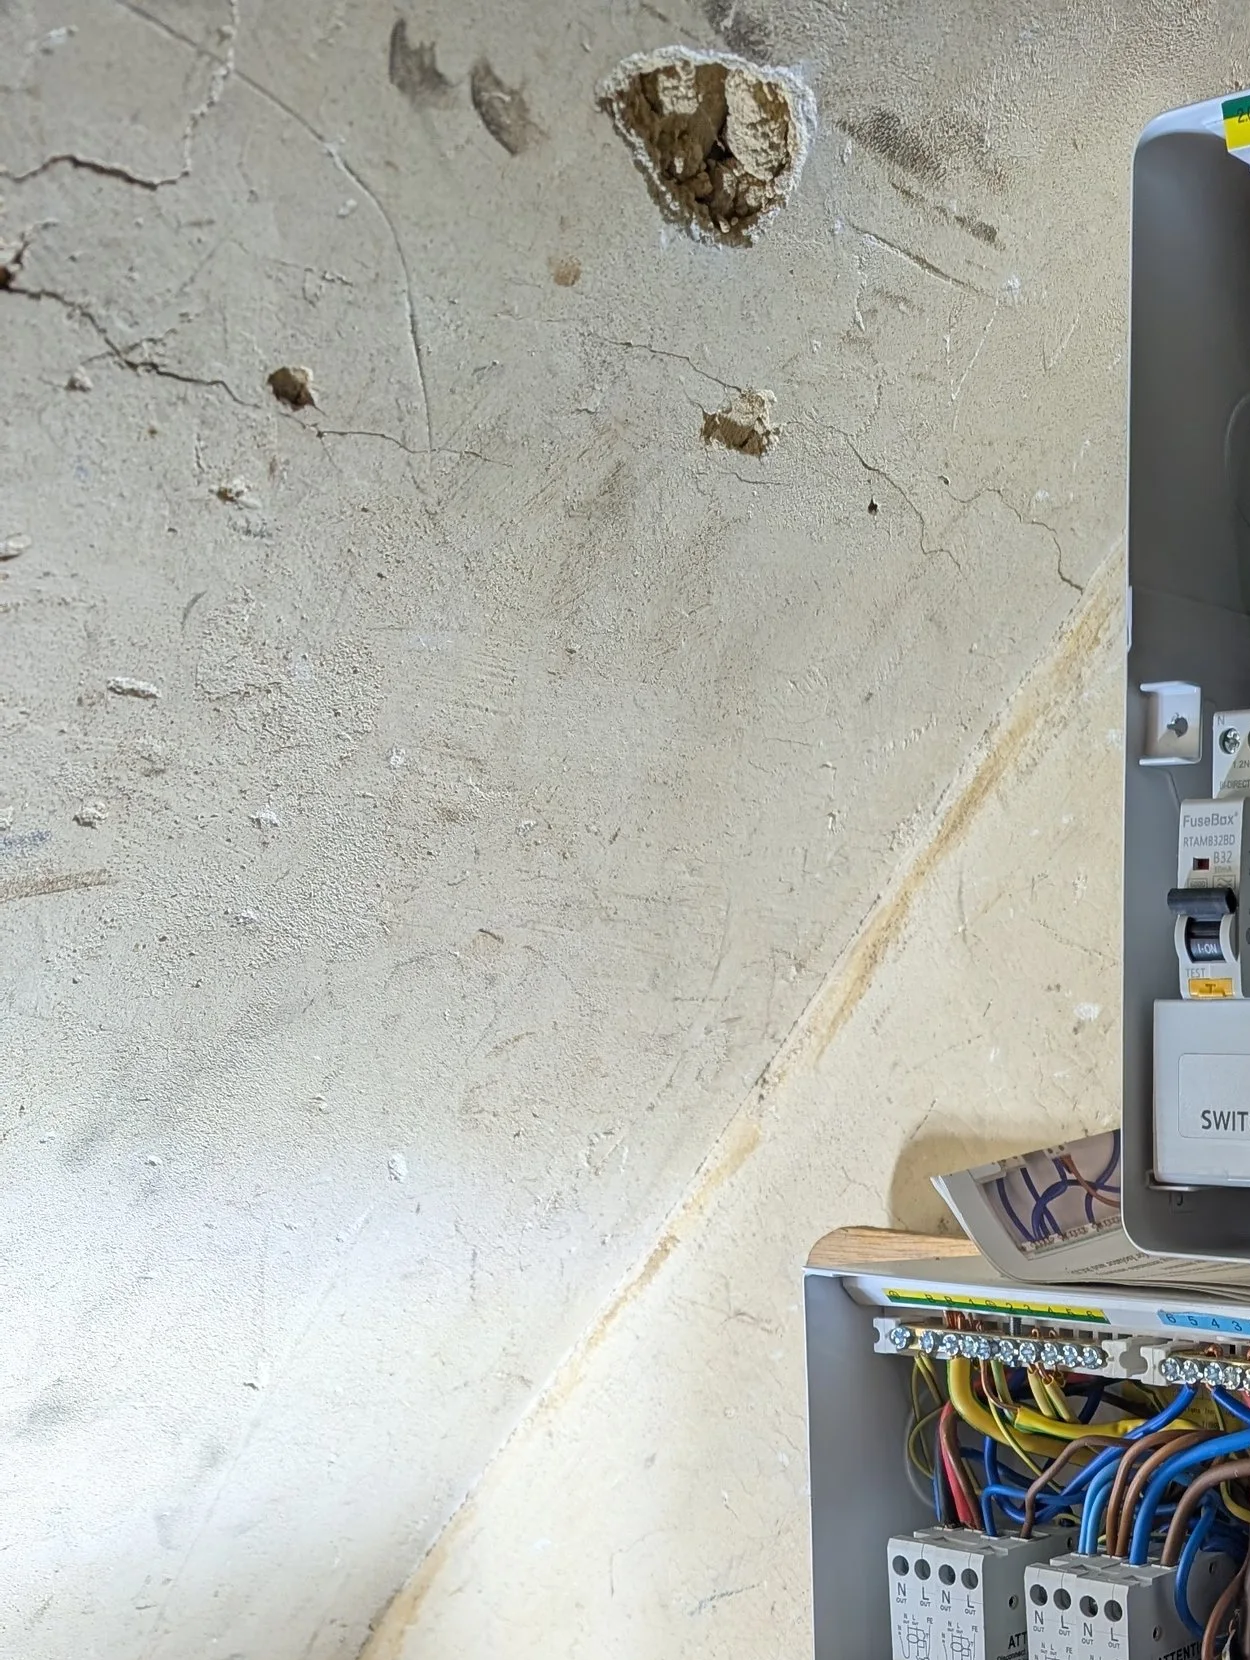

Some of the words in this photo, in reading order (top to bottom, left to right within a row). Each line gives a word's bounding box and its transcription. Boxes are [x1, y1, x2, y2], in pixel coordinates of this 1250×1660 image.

[1217, 715, 1224, 725] N
[1183, 834, 1235, 847] RTAMB32BD
[1213, 851, 1232, 864] B32
[1185, 968, 1205, 977] TEST
[1166, 1314, 1177, 1324] 6
[1188, 1316, 1198, 1326] 5
[1211, 1318, 1220, 1328] 4
[1232, 1320, 1242, 1331] 3
[897, 1582, 906, 1597] N
[922, 1586, 930, 1601] L
[942, 1590, 951, 1605] N
[967, 1594, 975, 1609] L
[965, 1608, 976, 1616] OUT
[1034, 1610, 1044, 1625] N
[1061, 1615, 1069, 1630] L
[1033, 1625, 1045, 1633] OUT
[1058, 1629, 1071, 1637] OUT
[1083, 1622, 1093, 1638] N
[1110, 1627, 1119, 1642] L
[1081, 1637, 1094, 1645] OUT
